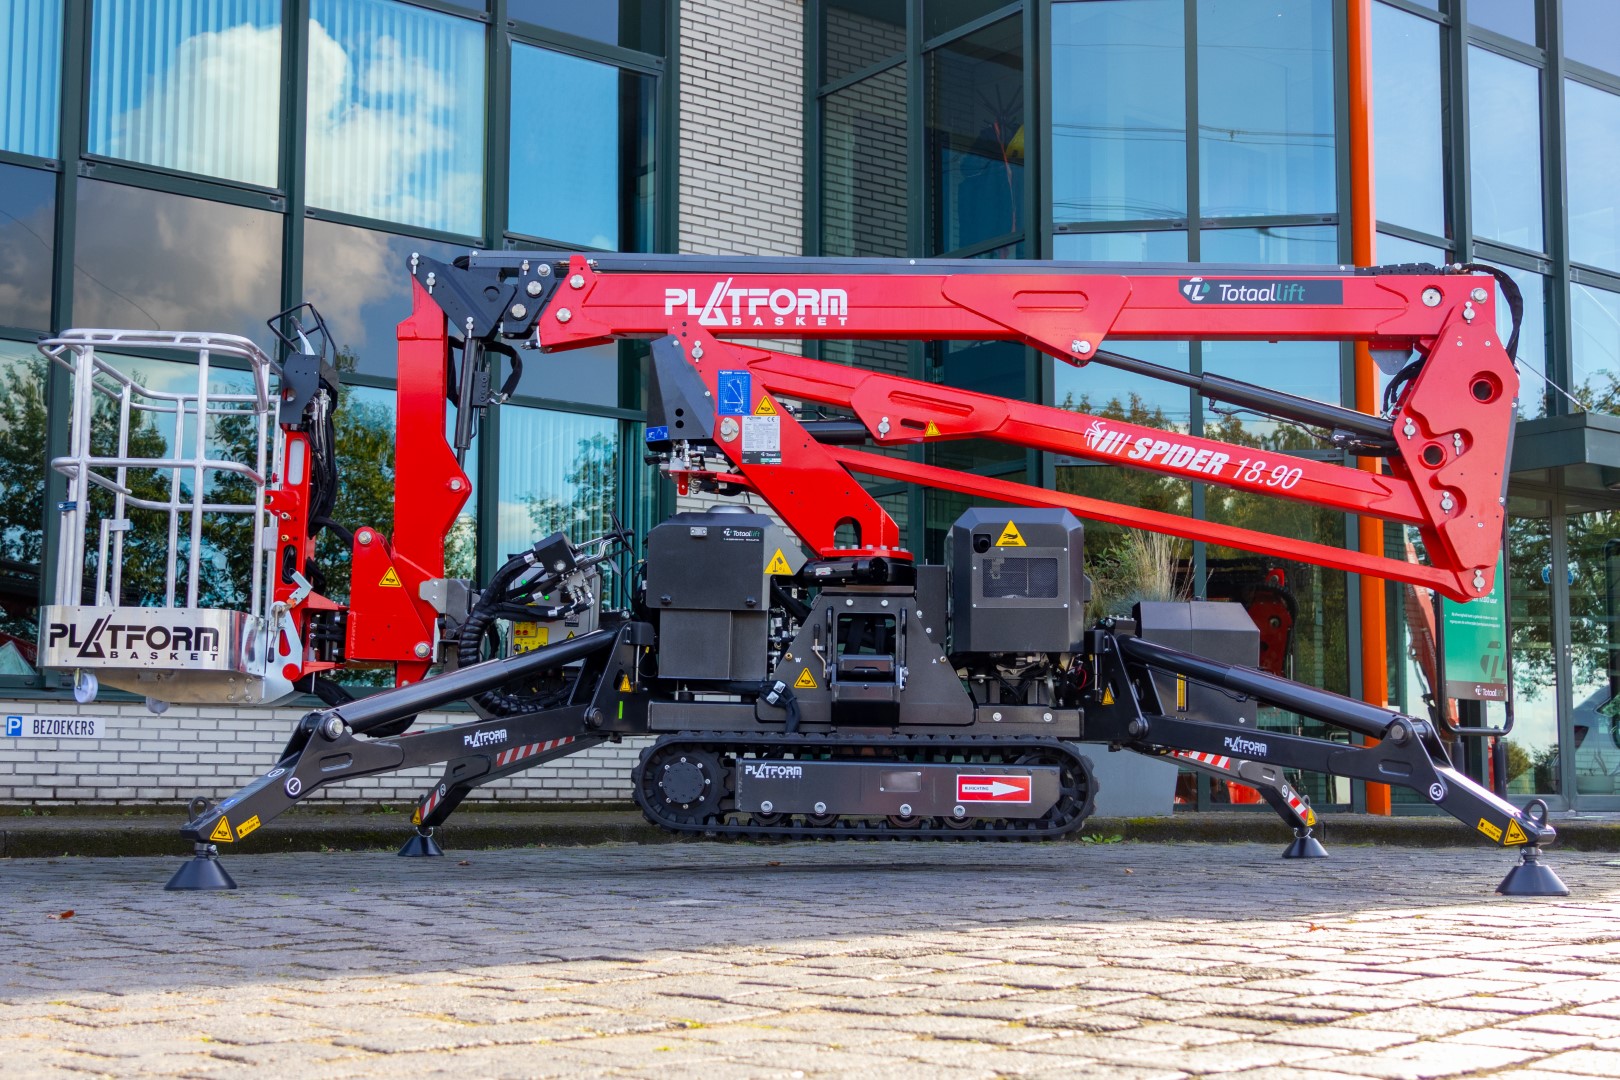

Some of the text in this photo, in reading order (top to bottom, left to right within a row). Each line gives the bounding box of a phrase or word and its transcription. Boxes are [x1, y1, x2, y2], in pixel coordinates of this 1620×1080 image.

[1219, 283, 1305, 301] Totaallift
[664, 277, 848, 326] PLATFORM
[731, 316, 848, 326] BASKET
[1127, 437, 1303, 490] SPIDER 18.90
[49, 614, 219, 658] PLATFORM
[109, 650, 219, 662] BASKET
[33, 719, 95, 736] BEZOEKERS
[463, 729, 508, 748] PLATFORM
[1223, 735, 1268, 755] PLATFORM
[745, 762, 803, 779] PLATFORM
